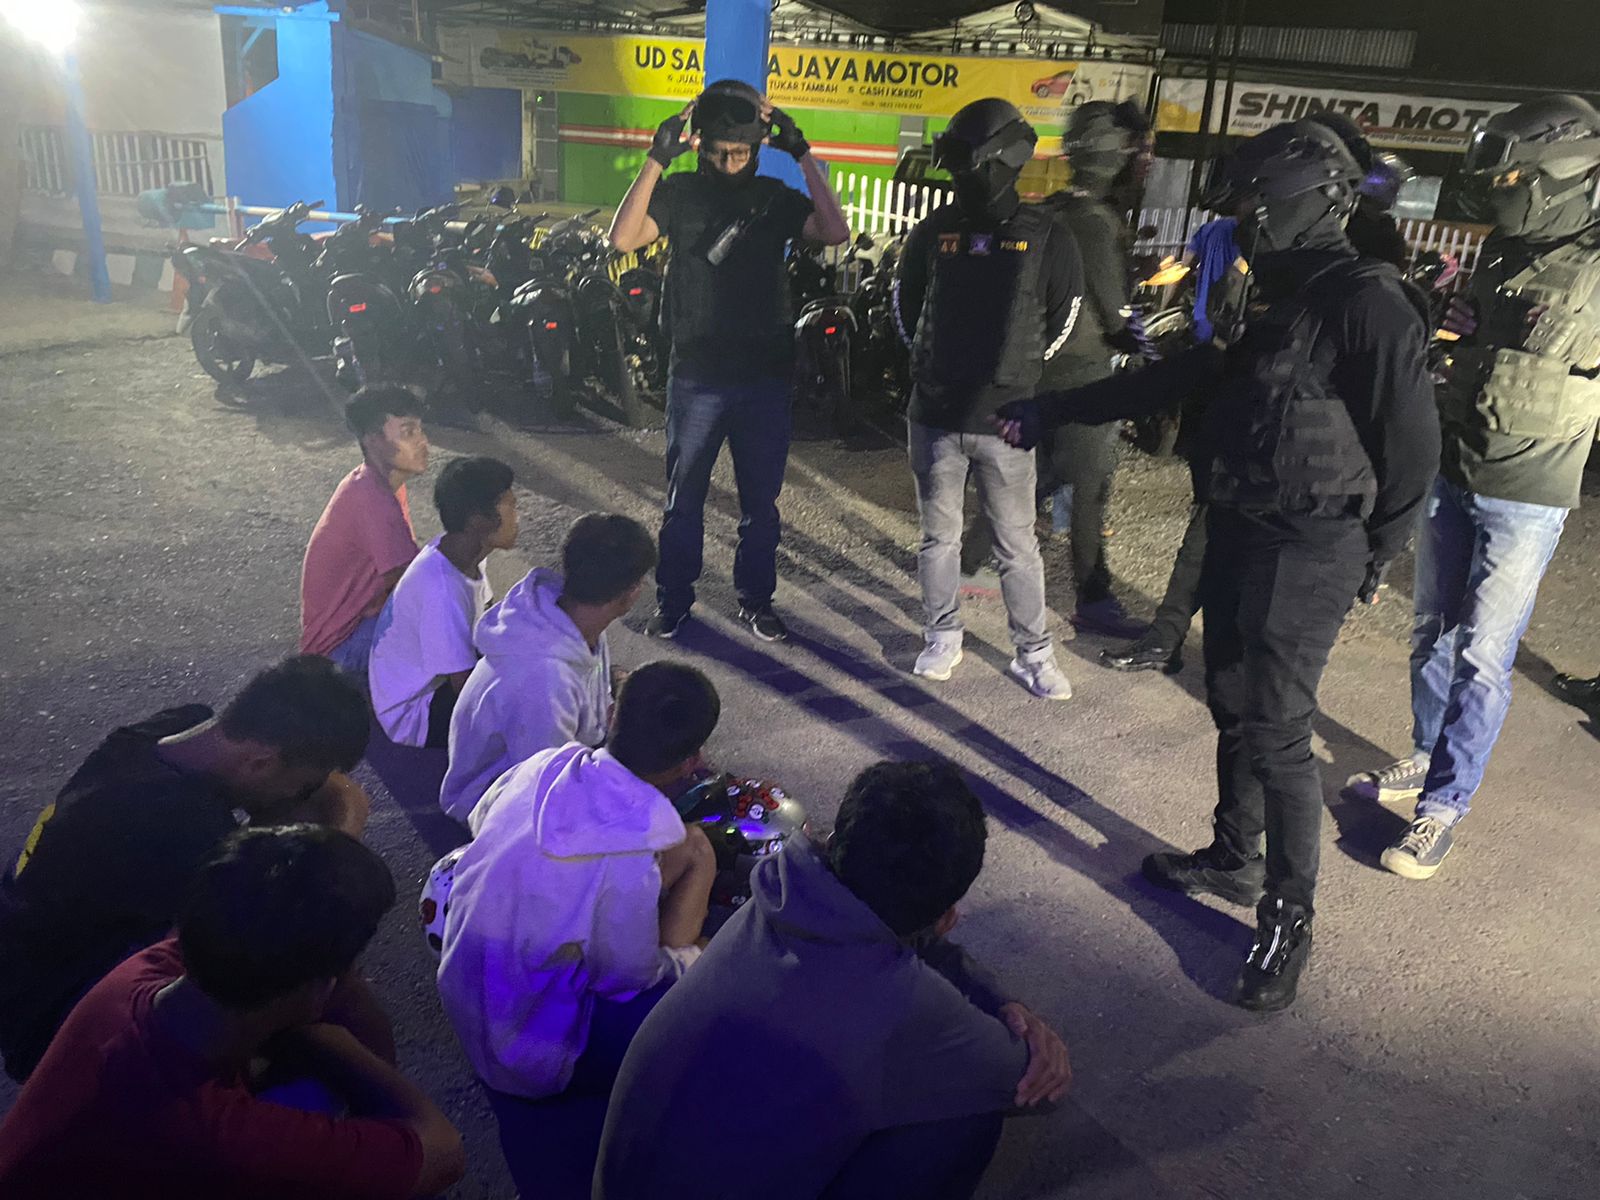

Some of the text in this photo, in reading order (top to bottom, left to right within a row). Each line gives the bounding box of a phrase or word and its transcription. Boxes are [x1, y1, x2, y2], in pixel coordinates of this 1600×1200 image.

[636, 46, 666, 69] UD
[787, 55, 858, 81] JAYA
[864, 60, 958, 88] MOTOR
[769, 81, 798, 90] TUKAR
[801, 82, 838, 93] TAMBAH
[1236, 92, 1491, 133] SHINTA MOT
[1000, 240, 1028, 251] POLISI
